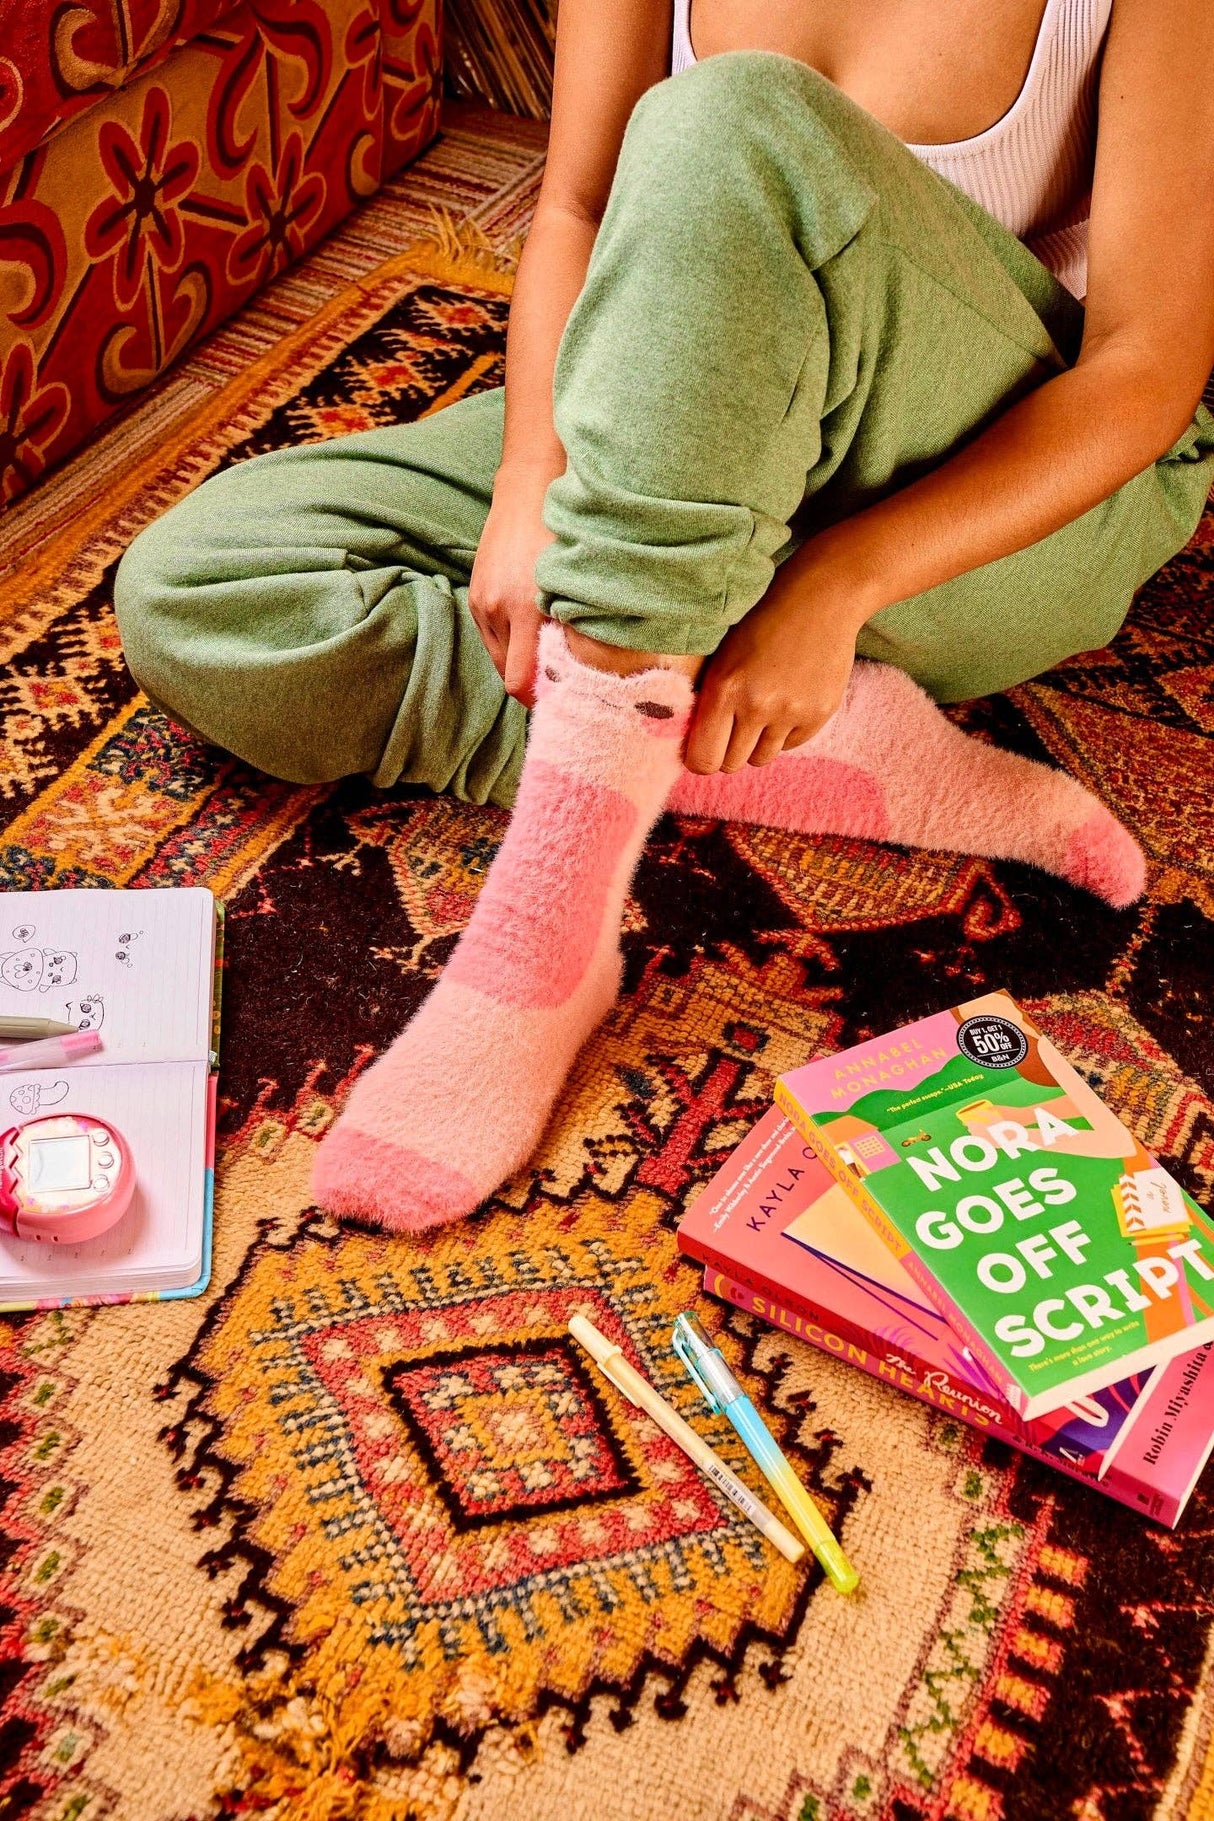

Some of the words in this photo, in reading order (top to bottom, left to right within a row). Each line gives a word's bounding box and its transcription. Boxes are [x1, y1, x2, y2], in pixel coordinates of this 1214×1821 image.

[831, 1046, 947, 1099] MONAGHAN
[834, 1039, 923, 1080] ANNABEL
[972, 1031, 1010, 1054] 50%
[990, 1053, 1010, 1063] B&N
[999, 1042, 1012, 1050] OFF
[901, 1097, 921, 1109] perfect
[779, 1093, 807, 1131] NORA
[809, 1132, 836, 1169] GOES
[838, 1171, 859, 1197] OFF
[861, 1199, 902, 1252] SCRIPT
[905, 1107, 1079, 1193] NORA
[746, 1167, 805, 1232] KAYLA
[915, 1167, 1077, 1249] GOES
[702, 1254, 754, 1286] KAYLA
[761, 1286, 819, 1321] OLSON
[976, 1220, 1092, 1294] OFF
[752, 1297, 867, 1365] SILICON
[908, 1261, 945, 1312] ANNABEL
[949, 1313, 1003, 1384] MONAGHAN
[994, 1238, 1214, 1358] SCRIPT
[885, 1353, 917, 1375] The
[923, 1371, 1003, 1425] Reunion
[1143, 1422, 1173, 1465] Robin
[1164, 1351, 1207, 1421] Miyashita
